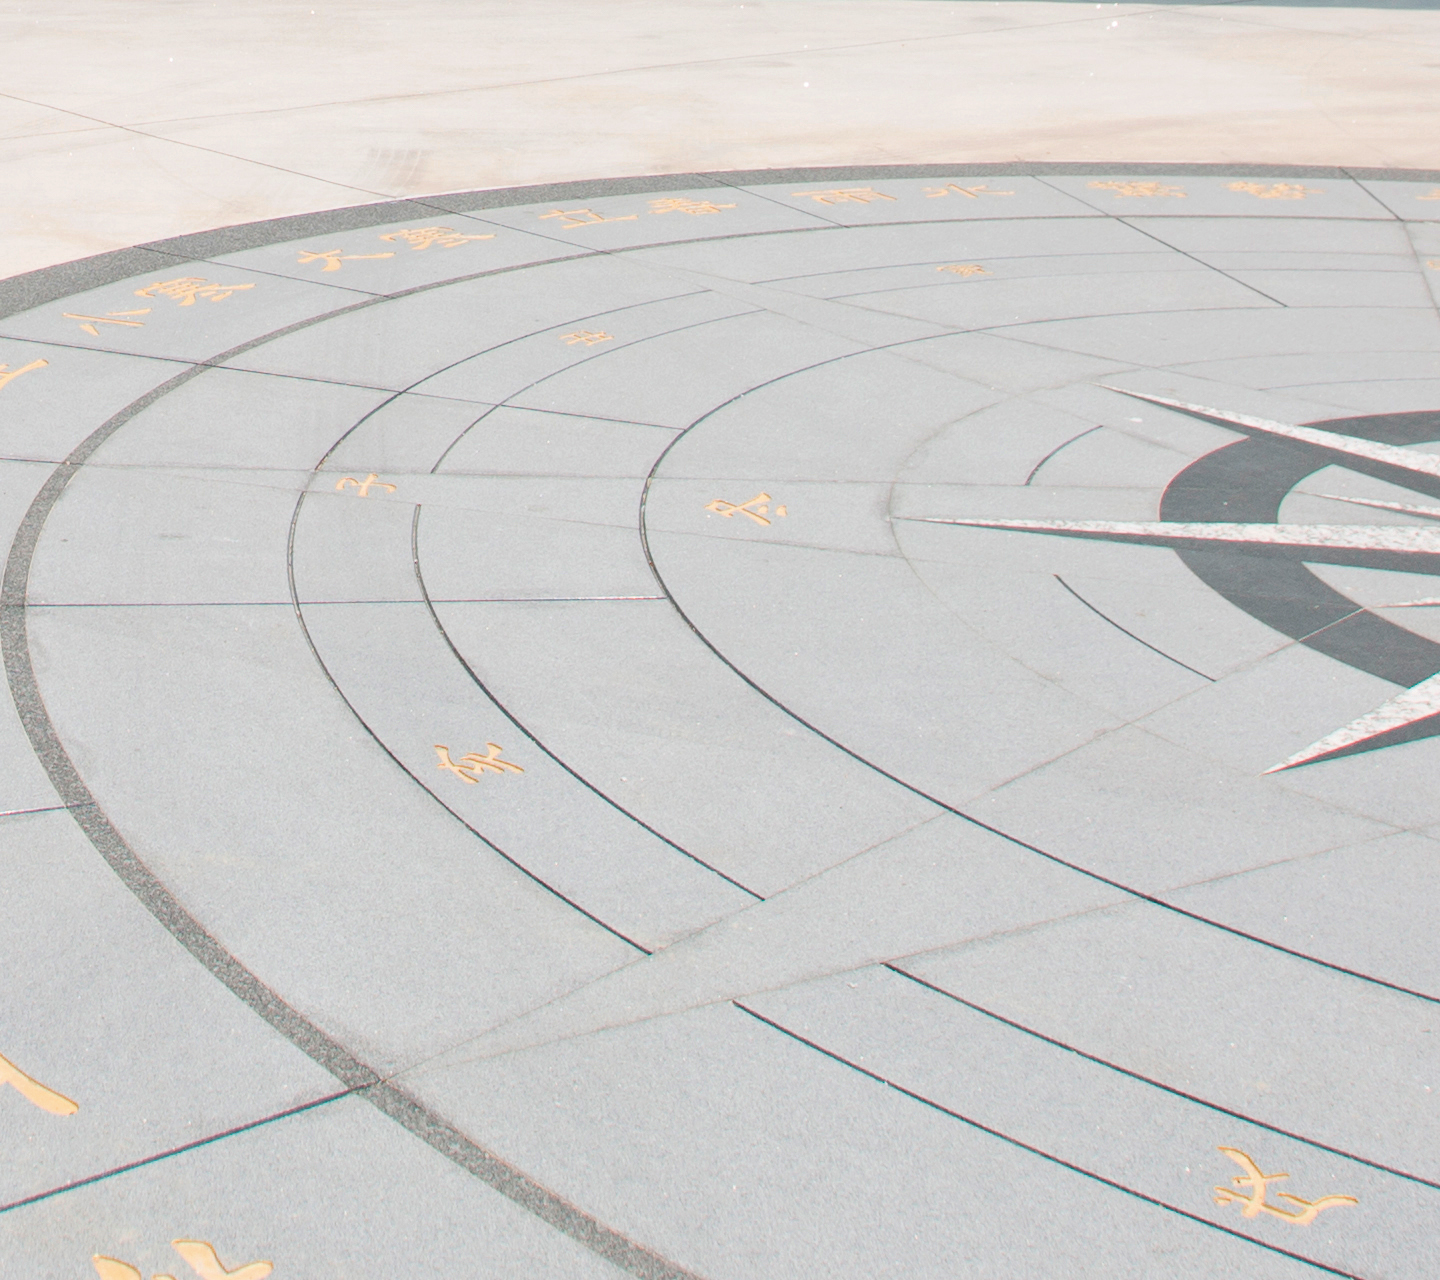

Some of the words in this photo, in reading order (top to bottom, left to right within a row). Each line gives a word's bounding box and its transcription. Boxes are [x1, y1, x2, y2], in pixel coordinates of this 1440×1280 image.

[538, 197, 738, 230] 立春
[334, 473, 399, 499] 子
[704, 491, 789, 527] 冬
